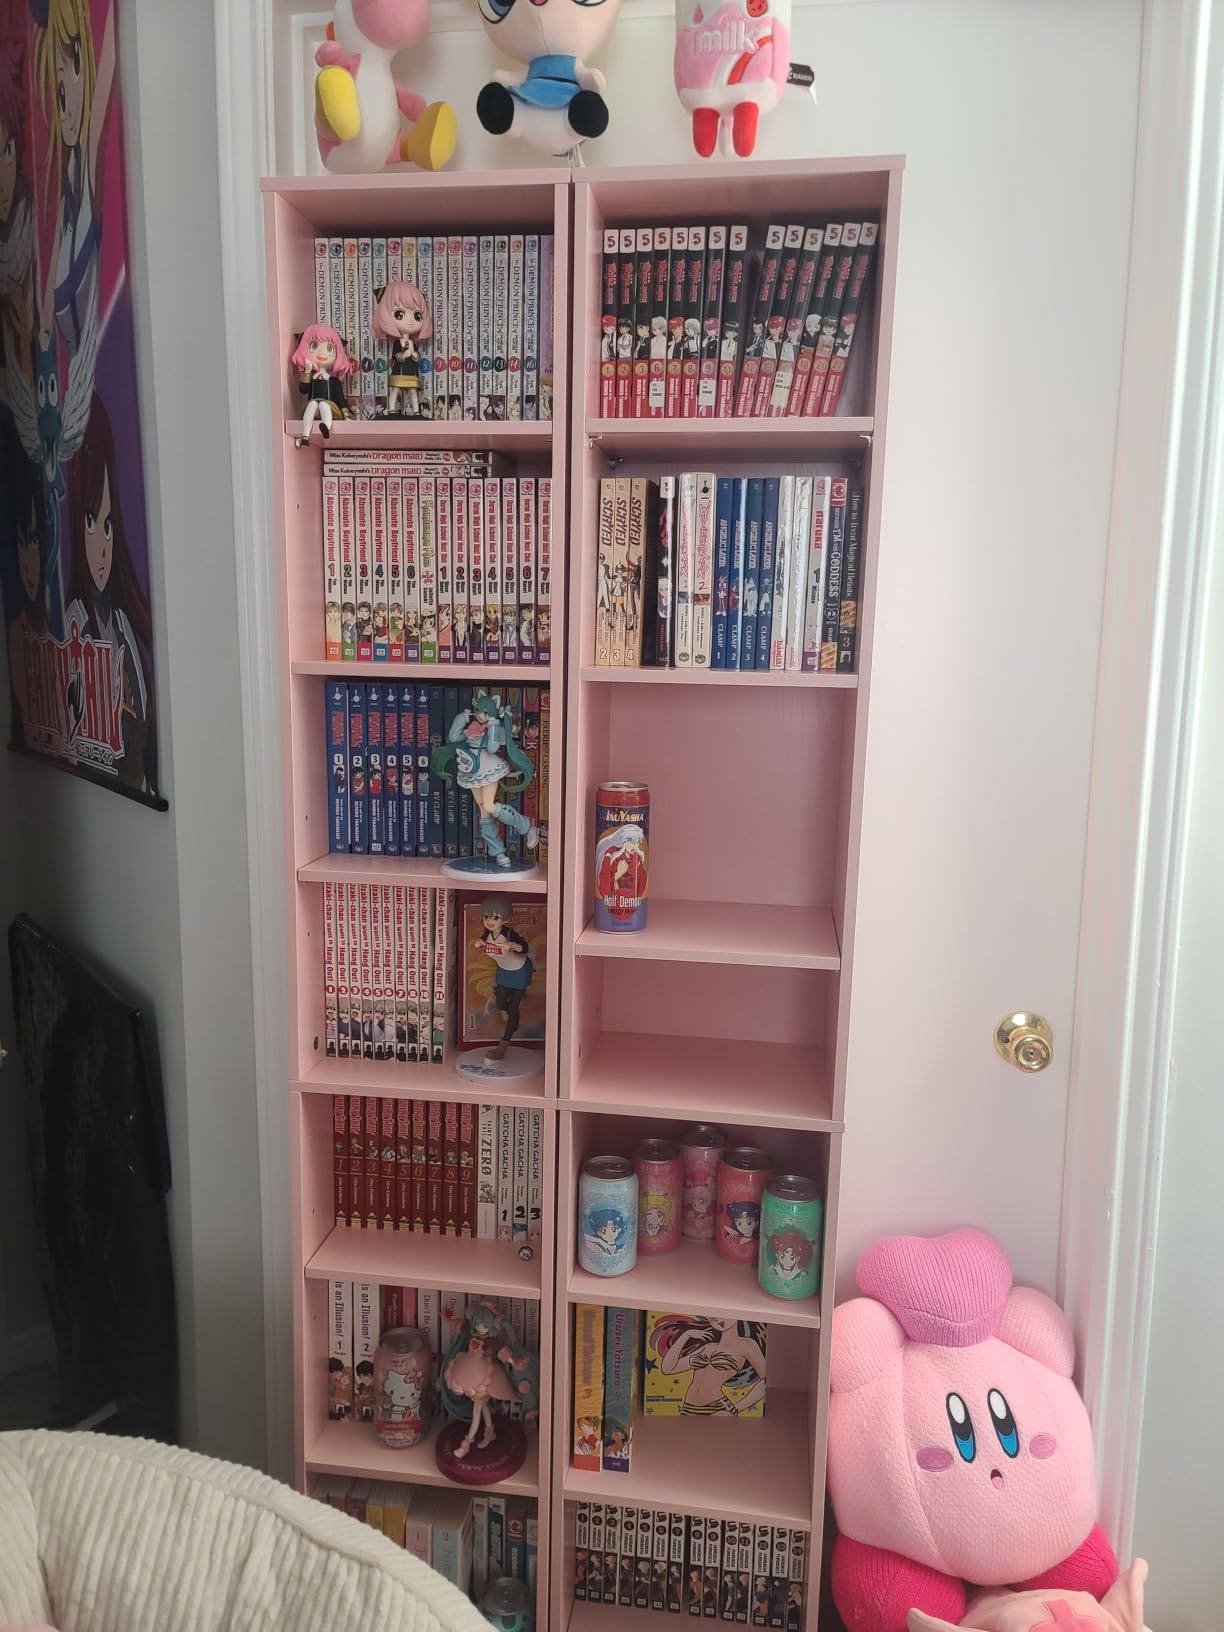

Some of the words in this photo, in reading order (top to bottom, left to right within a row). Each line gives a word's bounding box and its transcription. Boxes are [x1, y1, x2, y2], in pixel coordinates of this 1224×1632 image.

[696, 20, 758, 52] milk
[346, 269, 355, 299] DEMON
[373, 451, 401, 461] Dragon
[371, 466, 400, 476] Dragon
[343, 498, 351, 527] Absolute
[391, 498, 399, 527] Absolute
[406, 498, 414, 528] Absolute
[327, 529, 335, 561] Boyfriend
[342, 530, 351, 562] Boyfriend
[359, 530, 367, 562] Boyfriend
[375, 530, 383, 562] Boyfriend
[391, 530, 399, 562] Boyfriend
[406, 531, 414, 563] Boyfriend
[328, 563, 335, 576] 1
[344, 564, 351, 577] 2
[360, 564, 367, 577] 3
[375, 564, 383, 578] 4
[392, 565, 399, 578] 5
[407, 565, 415, 579] 6
[440, 566, 447, 579] 1
[456, 567, 464, 580] 2
[473, 568, 481, 582] 3
[488, 567, 496, 580] 4
[506, 567, 514, 580] 5
[523, 566, 531, 579] 6
[541, 567, 549, 581] 7
[828, 552, 840, 597] GODDESS
[600, 648, 607, 659] 2
[613, 649, 620, 661] 3
[626, 649, 634, 660] 4
[325, 947, 333, 964] Hang
[338, 948, 347, 965] Hang
[373, 950, 381, 968] Hang
[503, 1209, 508, 1221] 1
[515, 1206, 526, 1218] 2
[530, 1208, 541, 1220] 3
[336, 1291, 343, 1300] an
[361, 1293, 369, 1302] an
[335, 1303, 344, 1337] Illusion!
[361, 1305, 371, 1339] Illusion!
[338, 1341, 342, 1349] 1
[364, 1343, 369, 1352] 2
